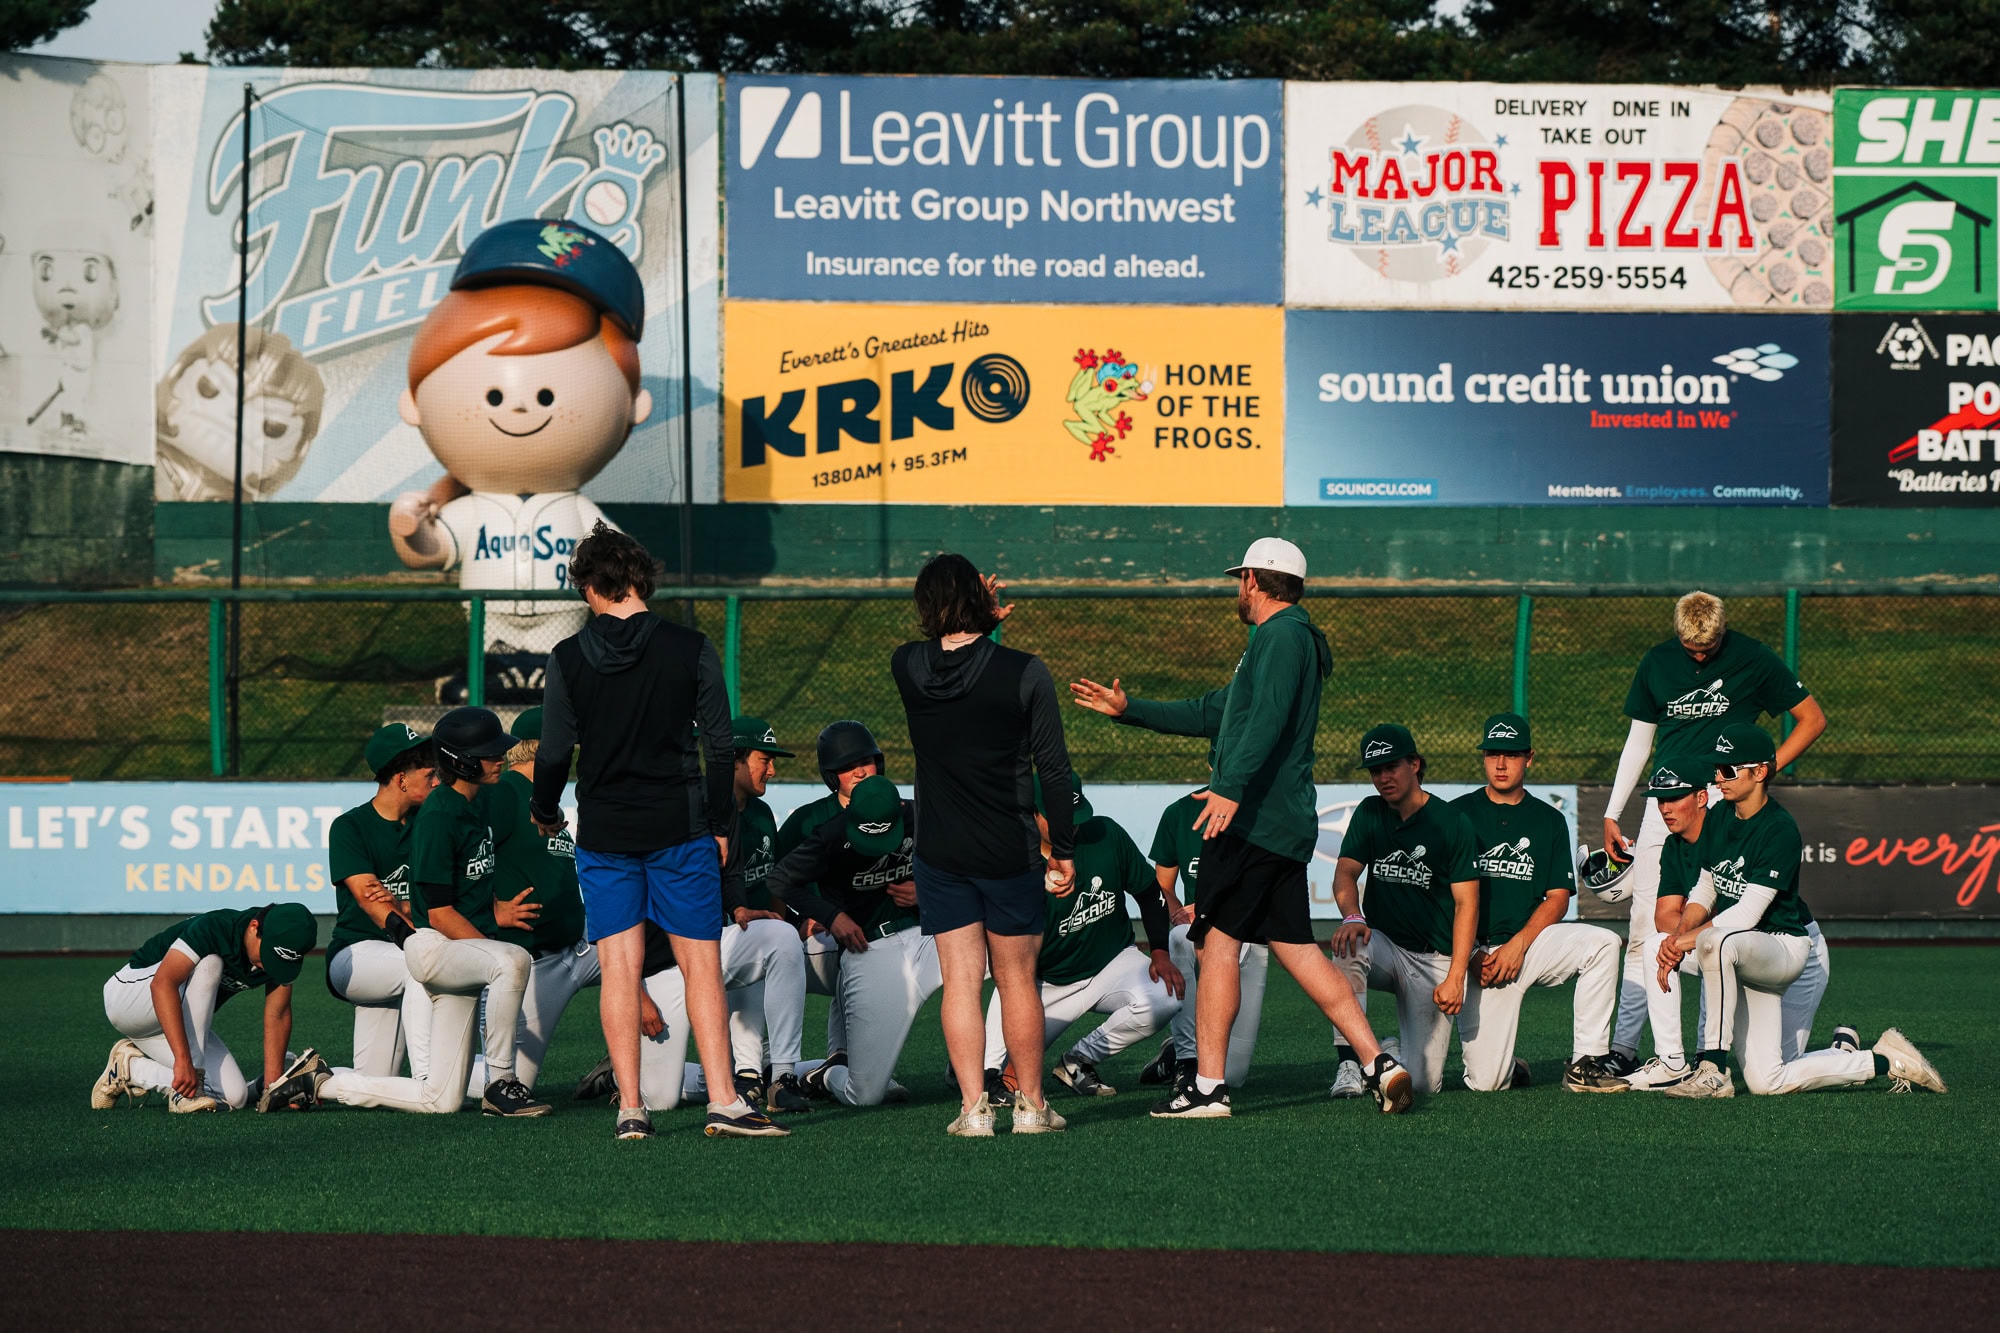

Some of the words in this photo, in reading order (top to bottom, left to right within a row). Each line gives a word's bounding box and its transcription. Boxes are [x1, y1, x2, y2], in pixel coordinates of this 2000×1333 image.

[1495, 98, 1587, 117] DELIVERY
[1613, 100, 1660, 117] DINE
[1671, 101, 1690, 118] IN
[840, 90, 1061, 166] Leavitt
[1075, 92, 1271, 187] Group
[1541, 127, 1592, 145] TAKE
[1604, 128, 1647, 145] OUT
[1331, 150, 1504, 200] MAJOR
[774, 187, 901, 220] Leavitt
[911, 188, 1029, 229] Group
[1040, 189, 1236, 223] Northwest
[1538, 160, 1755, 249] PIZZA
[1330, 200, 1508, 244] LEAGUE
[806, 251, 940, 277] Insurance
[947, 252, 986, 277] for
[992, 253, 1036, 277] the
[1045, 253, 1106, 278] road
[1113, 254, 1206, 279] ahead.
[302, 270, 441, 346] FIEL
[779, 342, 860, 374] Everett's
[864, 328, 948, 359] Greatest
[952, 319, 990, 344] Hits
[1165, 364, 1252, 386] HOME
[1318, 363, 1454, 403] sound
[1464, 363, 1592, 404] credit
[1600, 363, 1730, 405] union
[1156, 395, 1187, 418] OF
[1202, 395, 1260, 418] THE
[1590, 409, 1673, 429] Invested
[1676, 409, 1697, 429] in
[1698, 410, 1731, 429] We
[1155, 426, 1261, 449] FROGS.
[812, 461, 883, 488] 1380AM
[904, 446, 968, 472] 95.3FM
[1326, 482, 1432, 496] SOUNDCU.COM
[1548, 484, 1622, 498] Members.
[1624, 484, 1710, 500] Employees.
[1712, 484, 1804, 501] Community.
[1667, 701, 1730, 717] CASCADE
[8, 805, 151, 850] LET'S
[169, 805, 341, 850] START
[1819, 842, 1837, 863] is
[125, 863, 325, 892] KENDALLS
[852, 862, 913, 887] CASCAD
[1373, 863, 1433, 885] CASCADE
[1480, 859, 1535, 876] ASCADE
